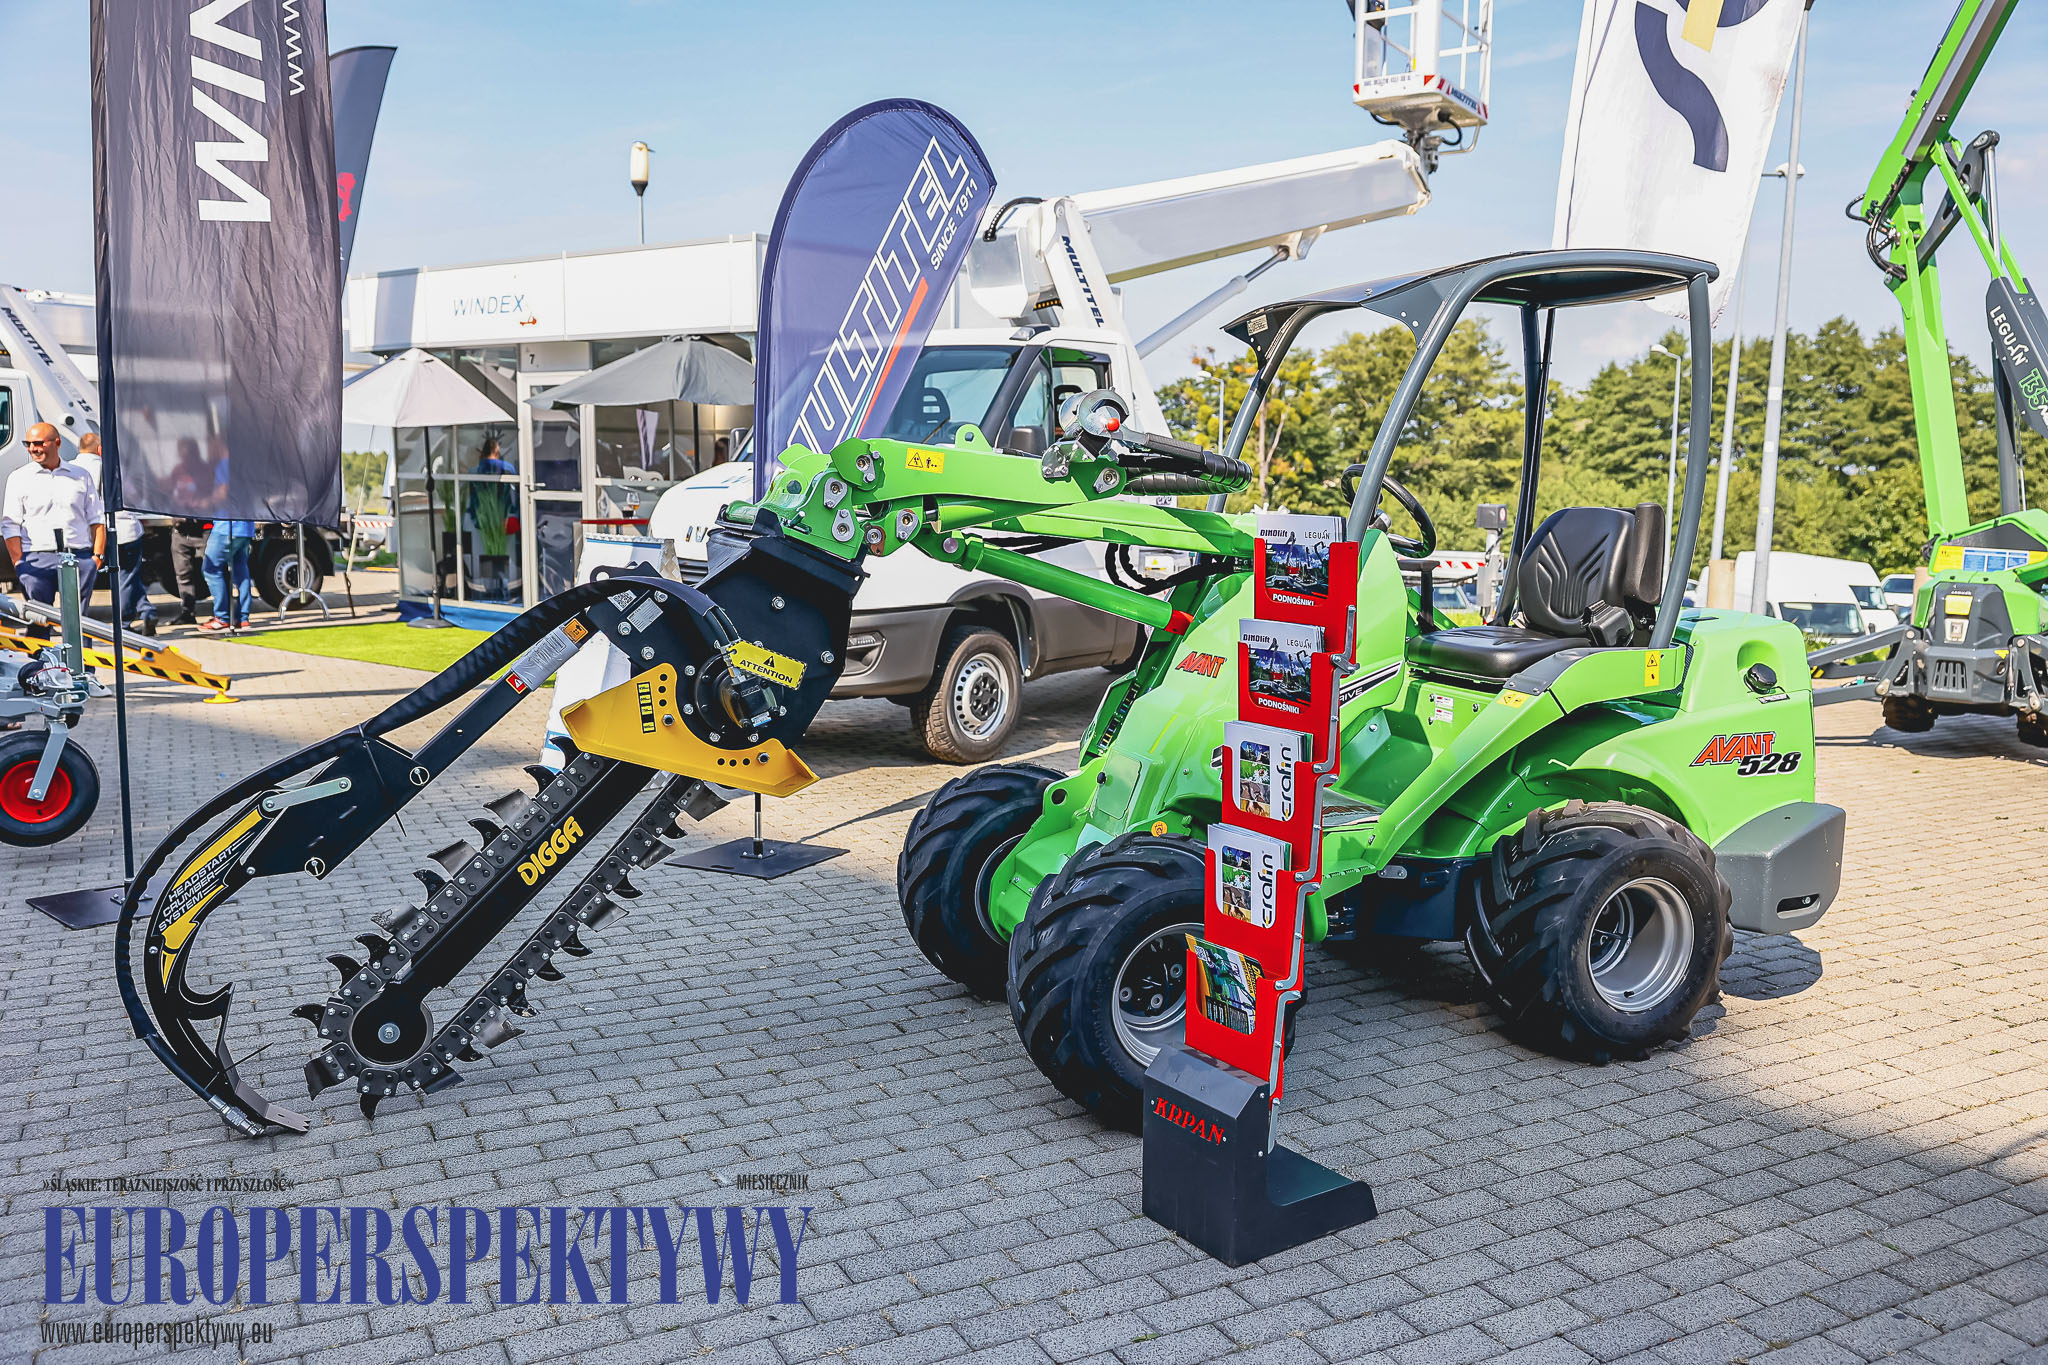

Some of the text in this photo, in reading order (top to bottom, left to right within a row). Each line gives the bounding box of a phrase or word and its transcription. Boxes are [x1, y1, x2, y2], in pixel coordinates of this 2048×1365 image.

[930, 178, 978, 270] SINCE 1911
[1062, 235, 1104, 327] MULTITEL
[450, 294, 524, 316] WINDEX
[1, 307, 54, 367] MULTITEL
[1272, 593, 1314, 606] PODNOŚNIKI
[739, 659, 793, 684] ATTENTION
[1175, 651, 1227, 678] AVANT
[1258, 697, 1300, 714] PODNOŚNIKI
[1689, 731, 1776, 767] AVANT
[1737, 752, 1802, 777] 528
[517, 816, 583, 885] DIGGA
[168, 845, 234, 902] HEADSTART
[158, 892, 204, 931] SYSTEM
[162, 871, 216, 917] CRUMBER
[1153, 1096, 1225, 1145] KRPAN
